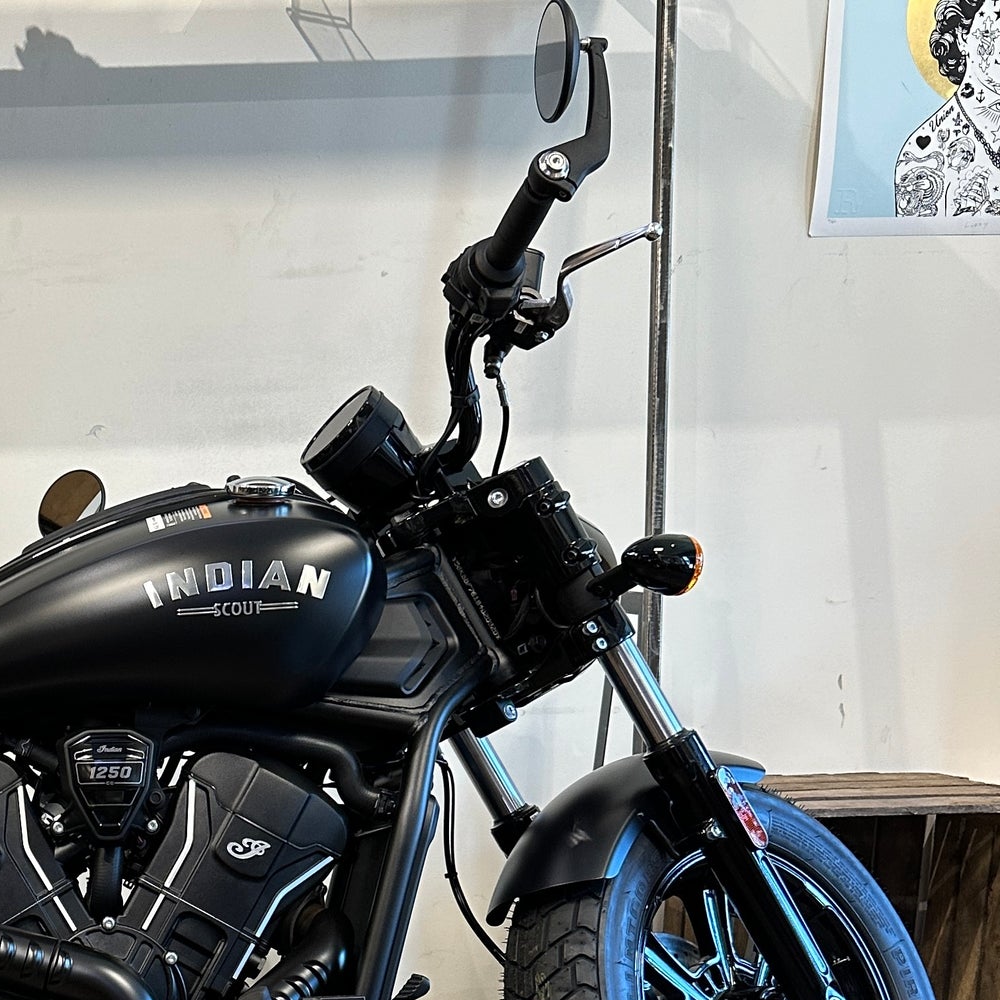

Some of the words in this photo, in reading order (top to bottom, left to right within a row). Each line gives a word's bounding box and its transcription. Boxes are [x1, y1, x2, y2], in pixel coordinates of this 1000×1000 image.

[929, 105, 955, 133] Union
[143, 560, 331, 609] INDIAN
[213, 601, 262, 617] SCOUT
[96, 745, 123, 753] Indian
[89, 766, 132, 780] 1250
